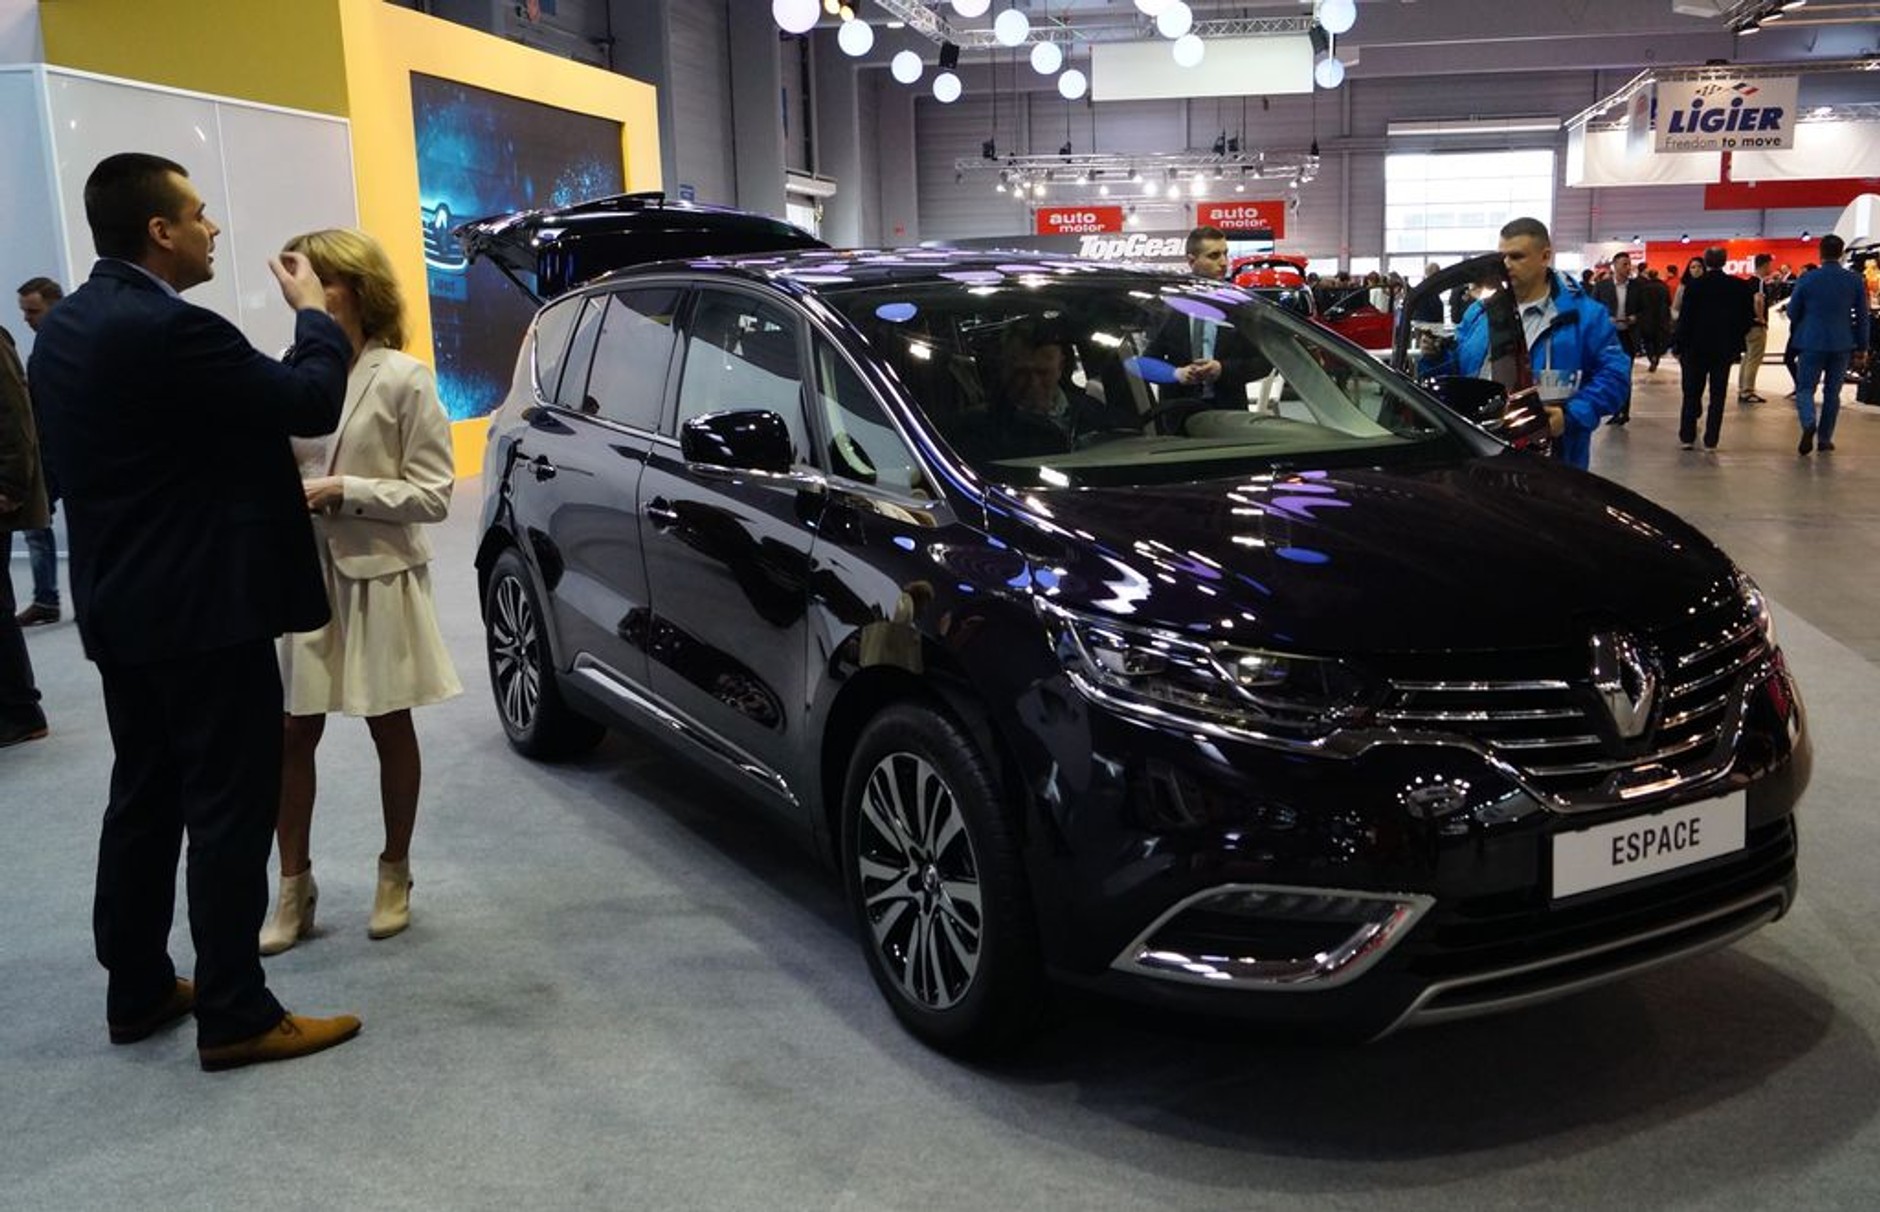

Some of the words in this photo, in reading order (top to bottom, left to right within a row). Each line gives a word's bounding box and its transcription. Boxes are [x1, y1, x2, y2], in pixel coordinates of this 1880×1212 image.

[1665, 136, 1717, 149] Freedom
[1722, 137, 1737, 148] to
[1742, 136, 1782, 147] move
[1049, 211, 1097, 225] auto
[1209, 206, 1258, 220] auto
[1059, 223, 1106, 233] motor
[1220, 218, 1268, 229] motor
[1611, 817, 1701, 866] ESPACE
